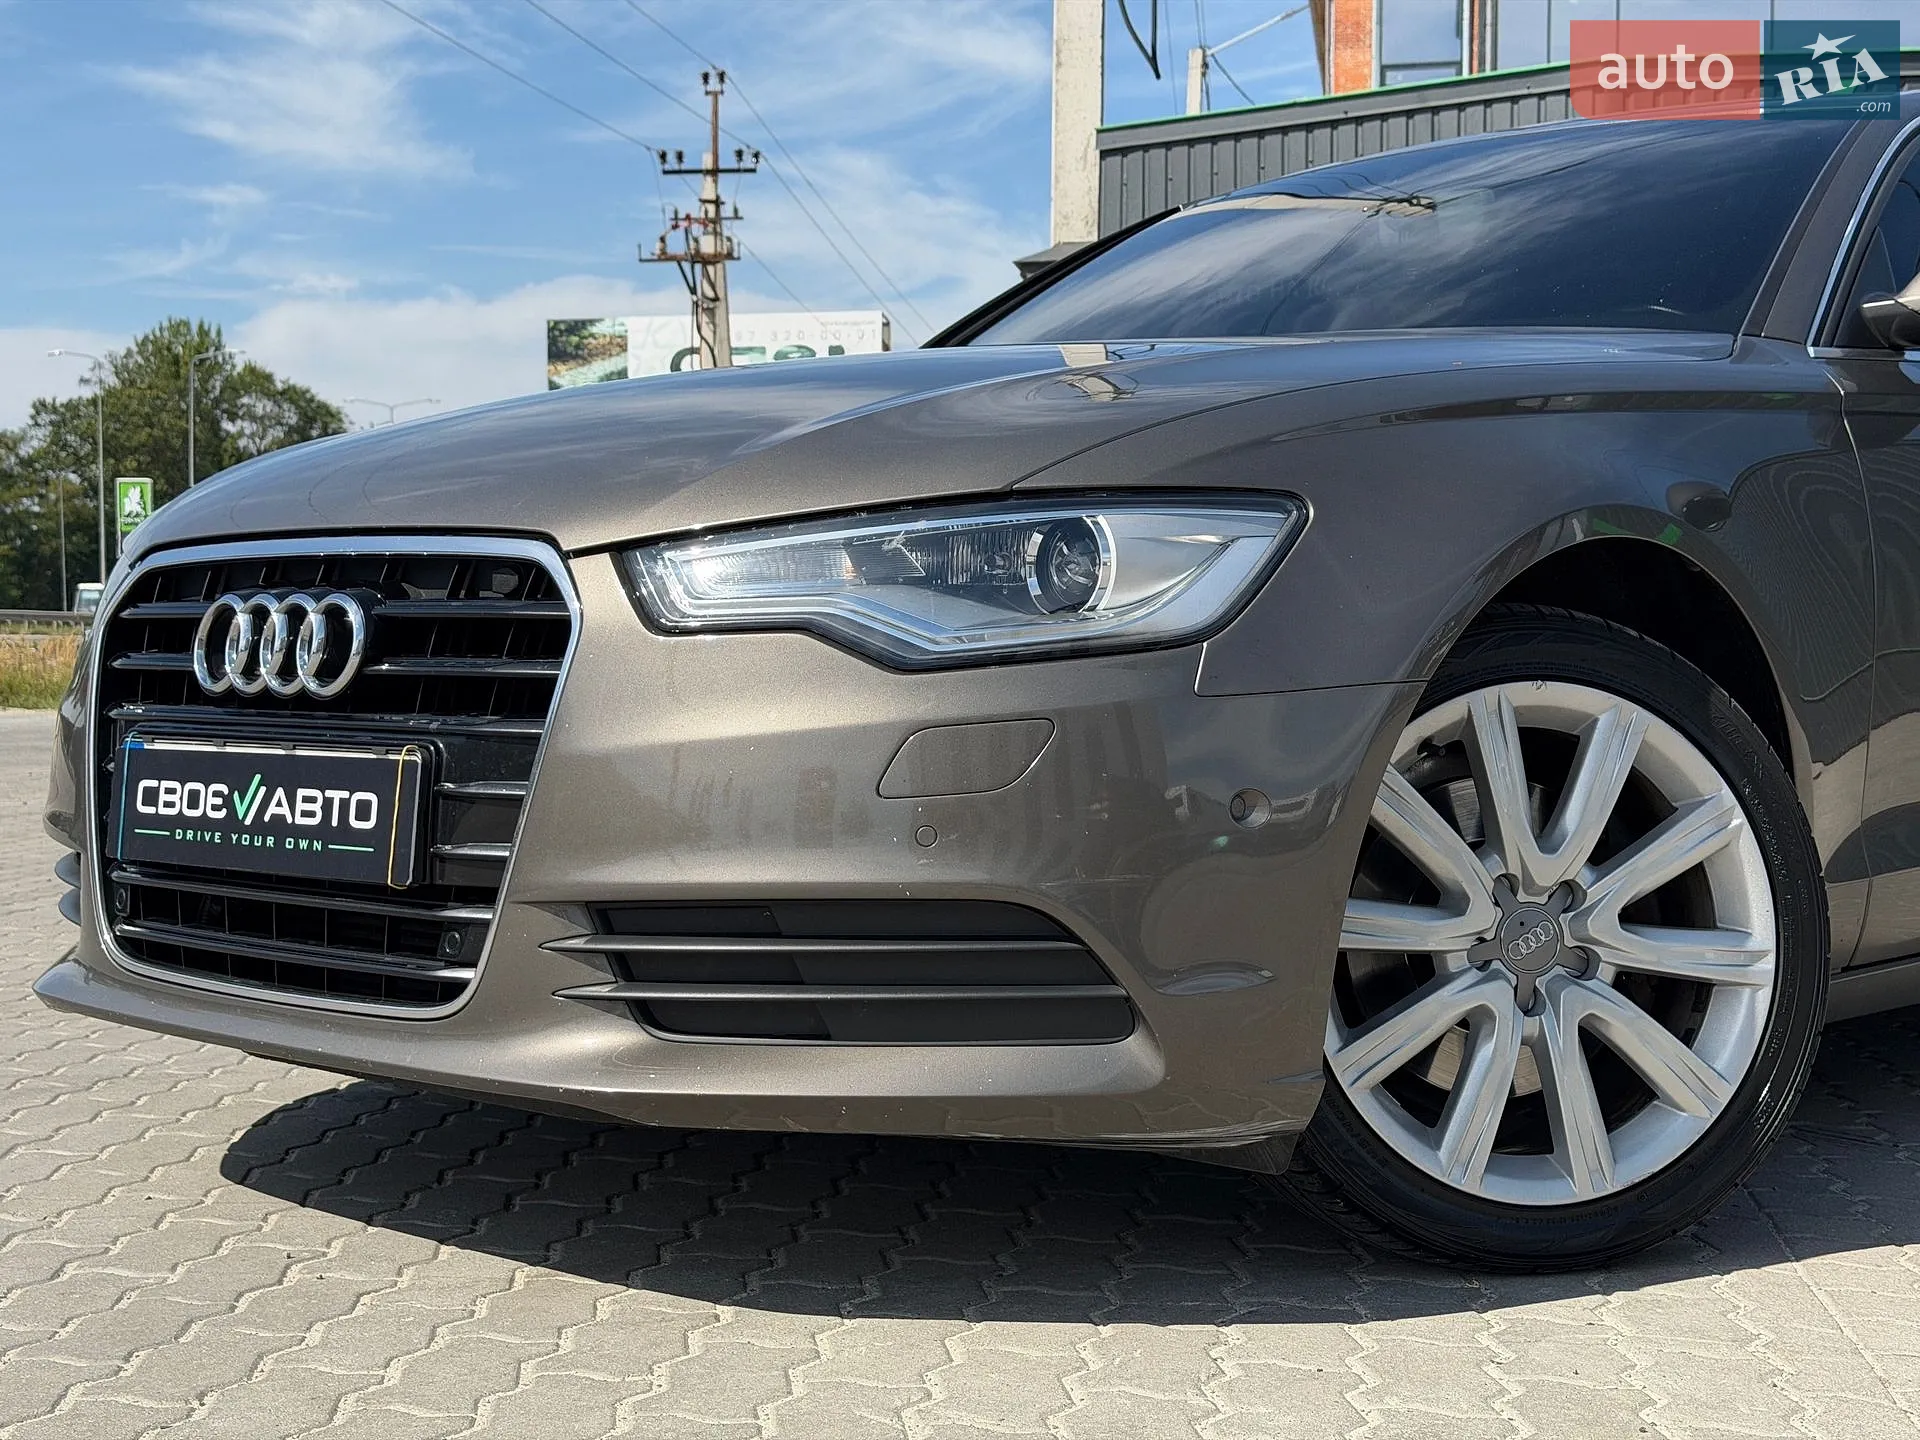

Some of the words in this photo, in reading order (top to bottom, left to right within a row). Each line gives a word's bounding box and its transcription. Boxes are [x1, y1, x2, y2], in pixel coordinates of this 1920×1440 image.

[264, 786, 378, 829] АВТО
[175, 829, 222, 843] DRIVE
[231, 833, 275, 847] YOUR
[286, 837, 322, 851] OWN
